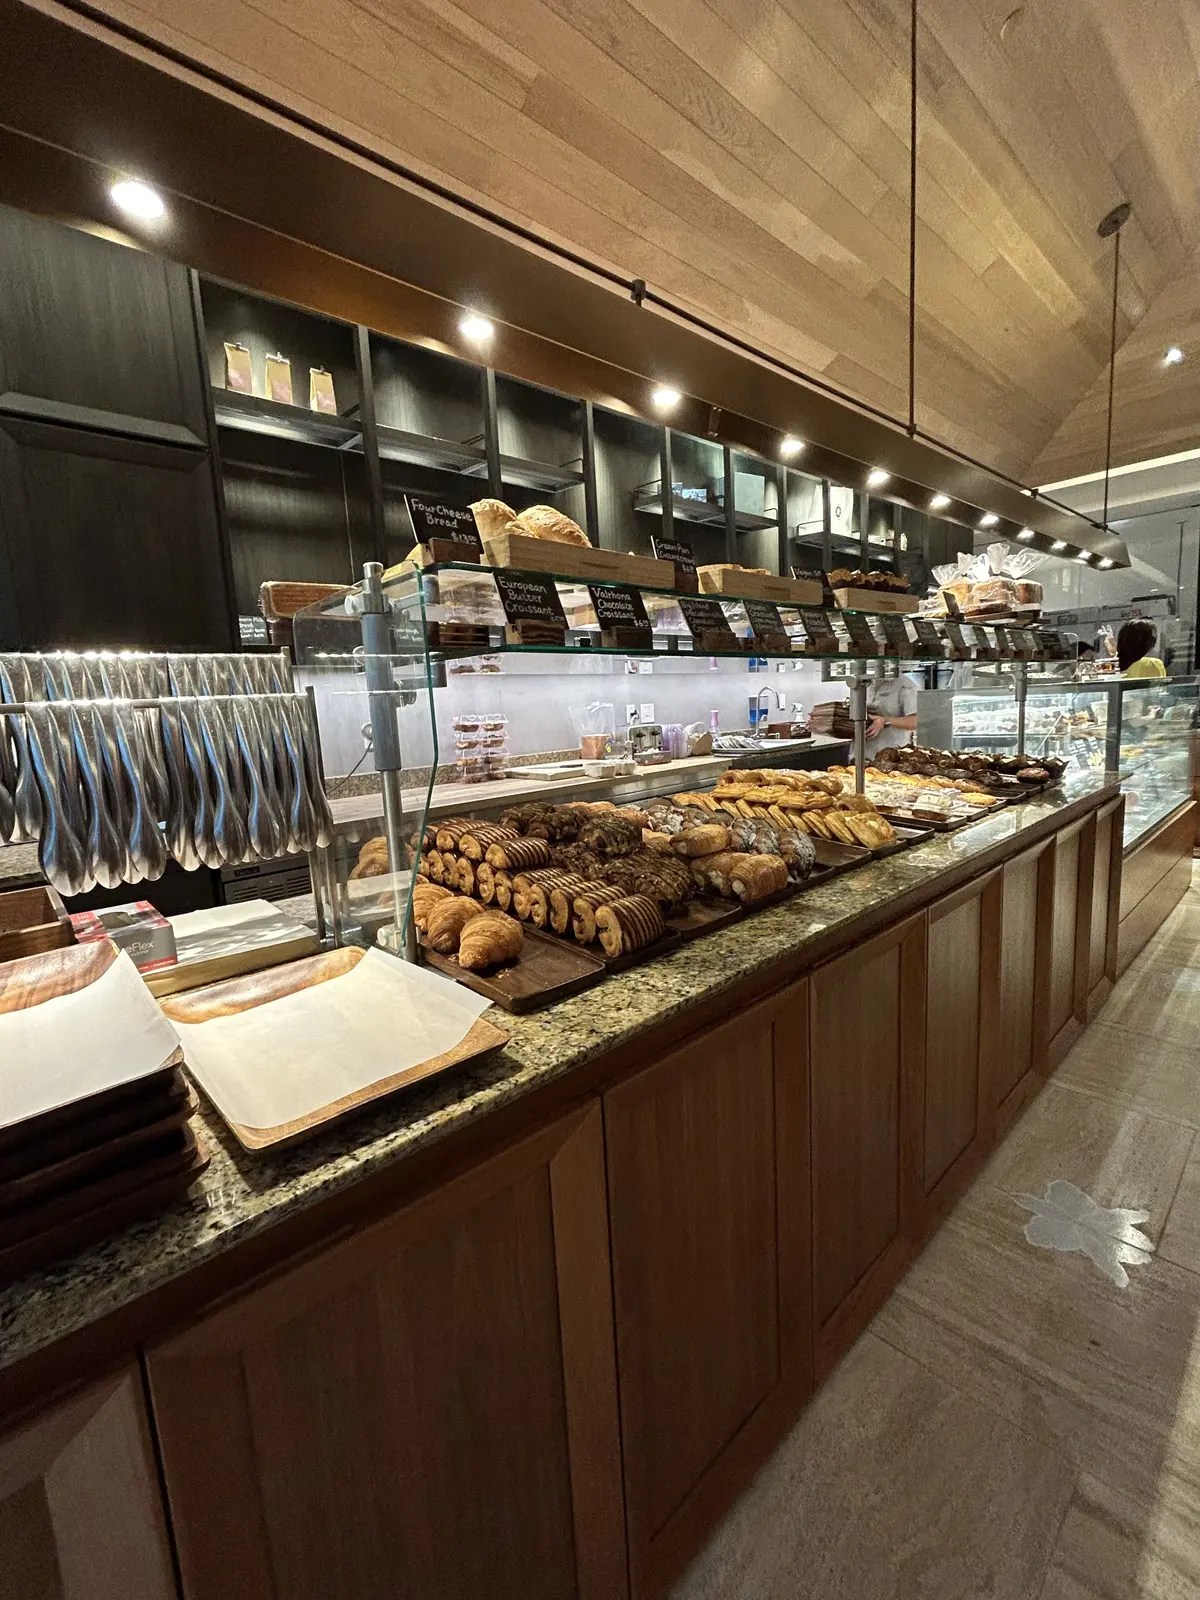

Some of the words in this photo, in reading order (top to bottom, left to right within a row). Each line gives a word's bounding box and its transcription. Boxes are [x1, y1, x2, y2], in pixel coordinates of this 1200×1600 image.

[426, 513, 459, 529] Bread
[498, 576, 548, 594] European
[508, 589, 542, 603] Butter
[591, 587, 632, 601] Valrhona
[505, 601, 554, 616] Croissant
[597, 599, 634, 611] Chocolate
[597, 608, 636, 620] Croissant
[125, 940, 155, 954] eFlex
